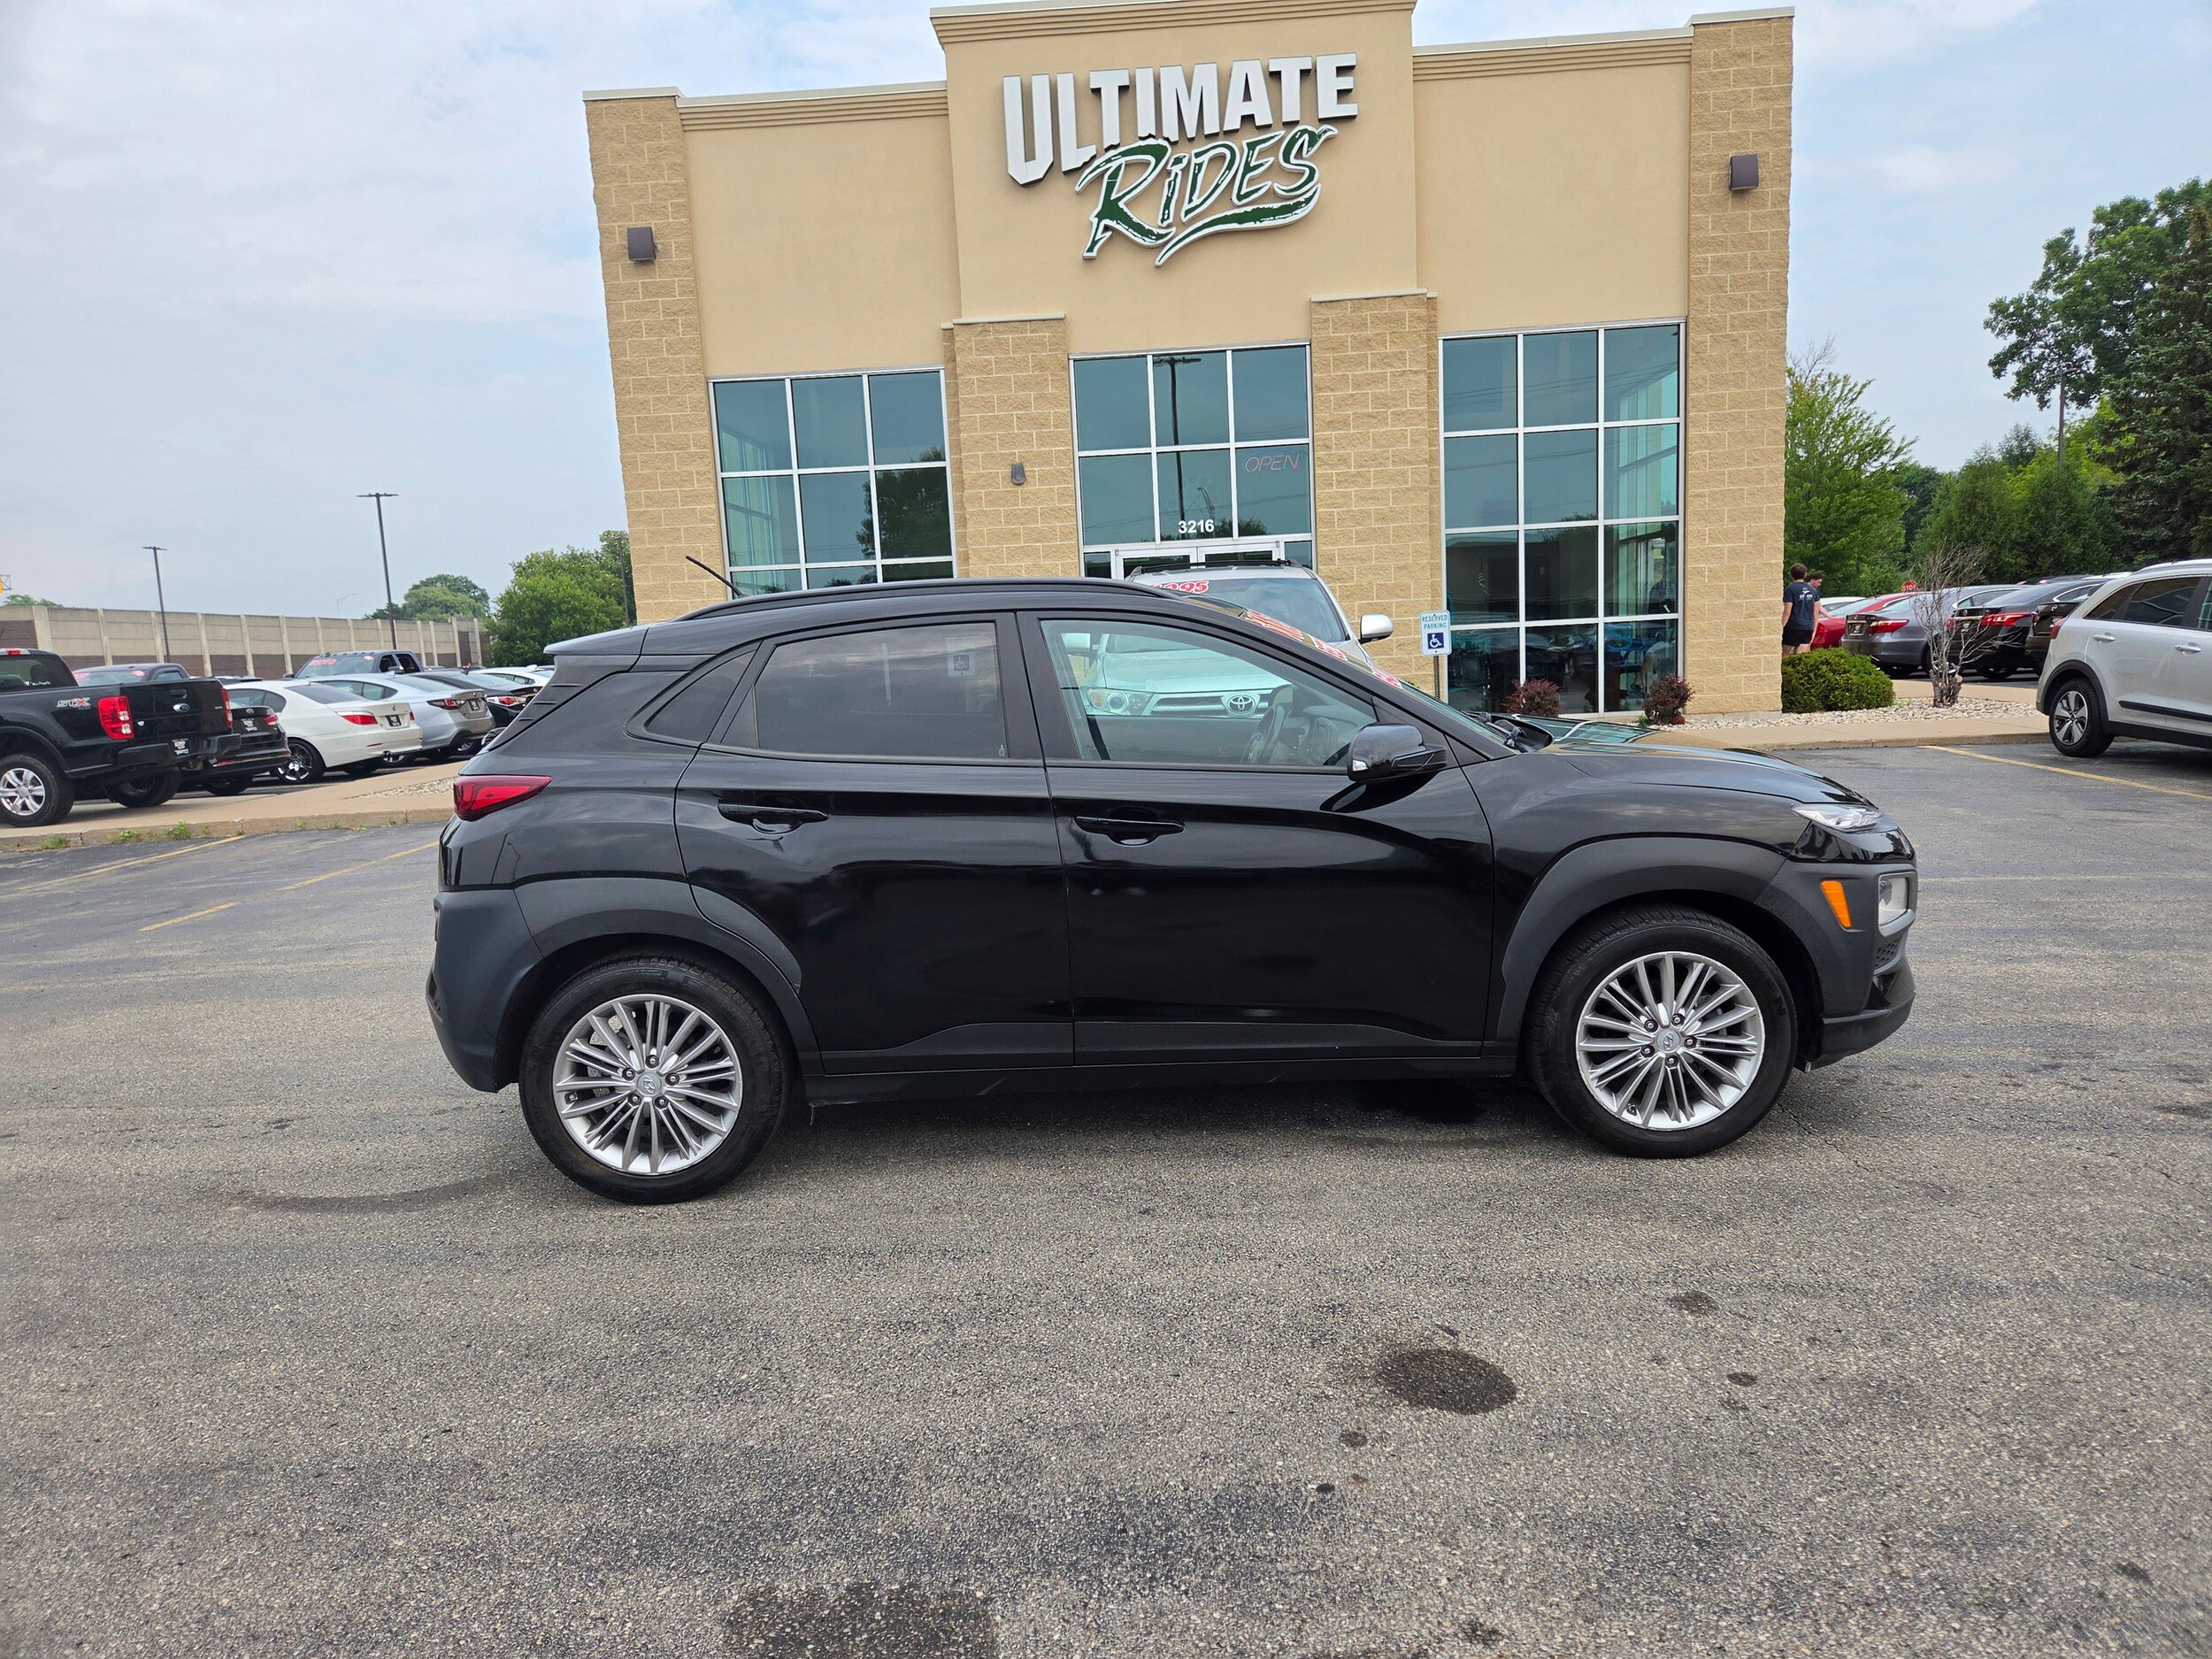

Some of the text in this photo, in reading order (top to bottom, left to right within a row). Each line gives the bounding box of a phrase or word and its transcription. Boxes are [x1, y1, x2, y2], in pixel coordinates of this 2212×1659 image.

[1002, 52, 1358, 188] ULTIMATE
[1245, 454, 1300, 472] OPEN
[1178, 518, 1215, 534] 3216
